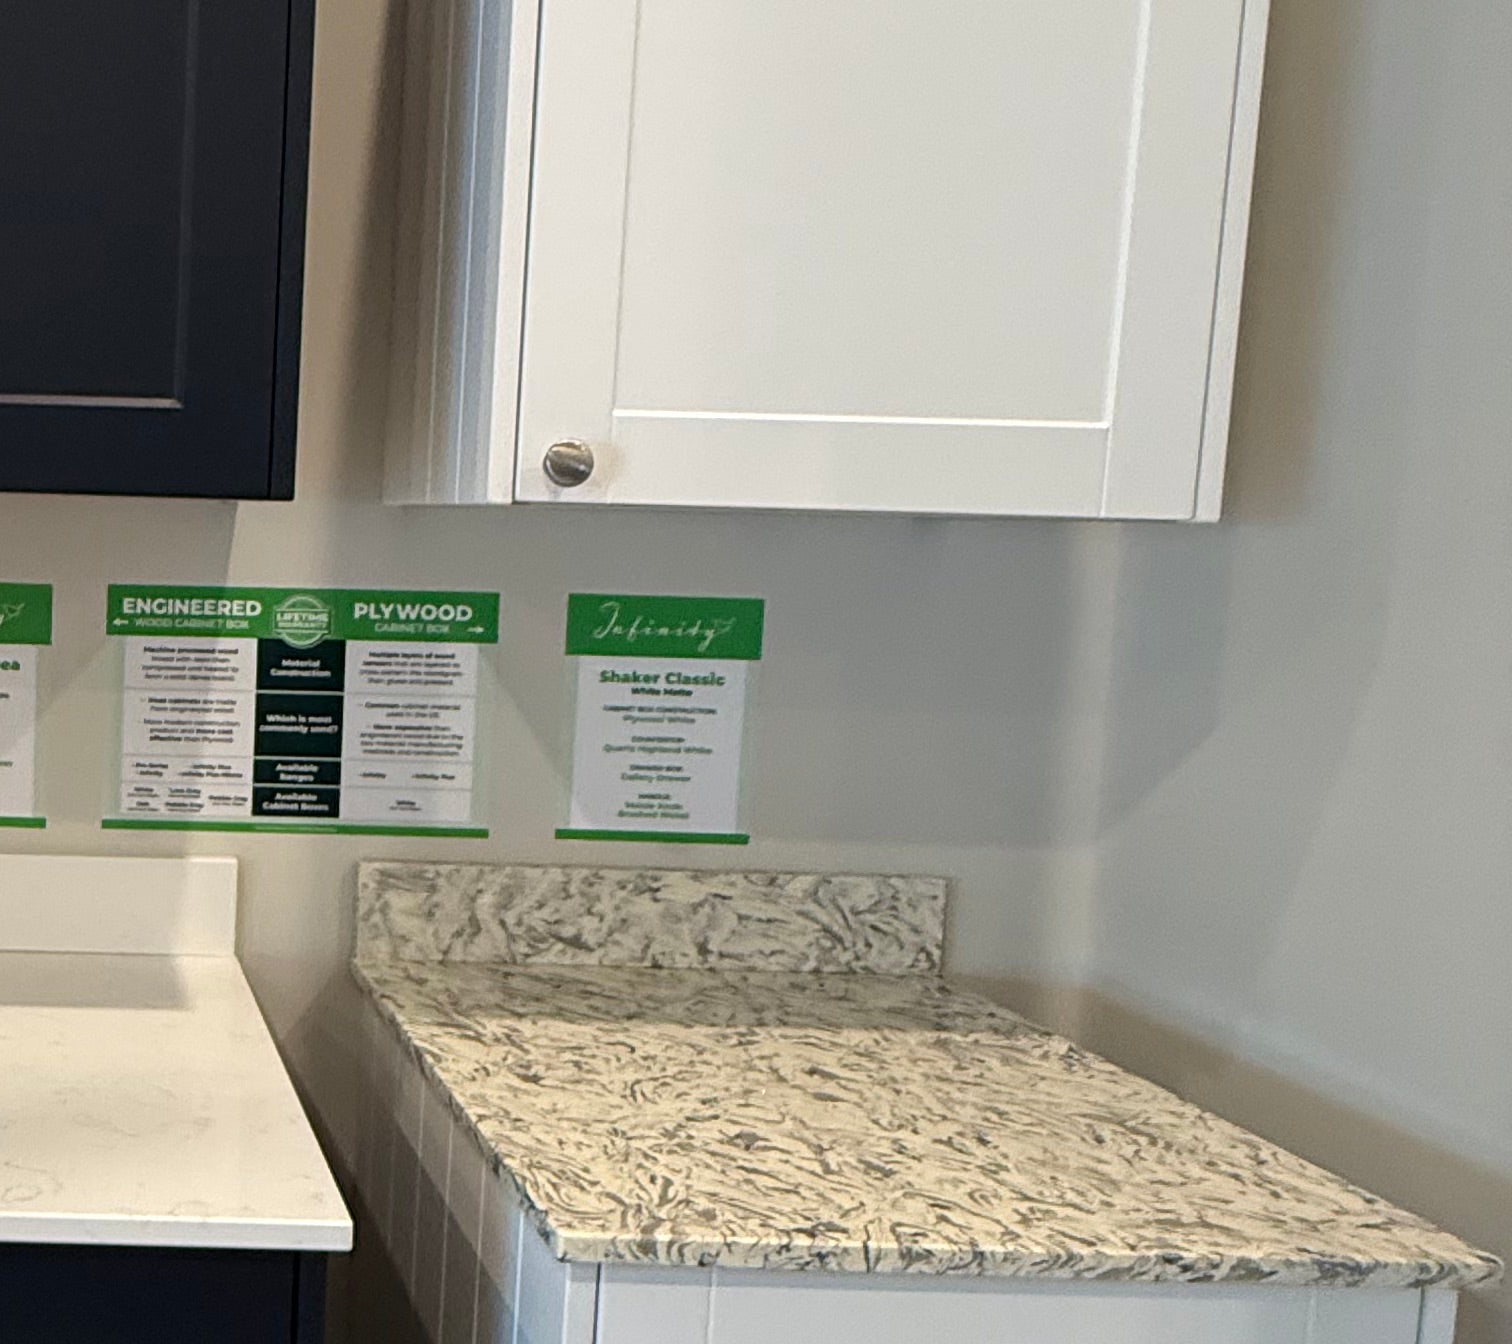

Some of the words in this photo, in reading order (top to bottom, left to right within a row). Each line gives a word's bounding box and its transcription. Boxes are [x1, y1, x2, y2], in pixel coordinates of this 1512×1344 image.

[122, 597, 262, 617] ENGINEERED
[354, 602, 473, 622] PLYWOOD
[226, 620, 249, 629] BOX
[276, 612, 329, 623] LIFETIME
[375, 623, 424, 633] CABINET
[426, 624, 450, 634] BOX
[593, 601, 716, 652] Infinity
[599, 669, 660, 684] Shaker
[665, 672, 726, 686] Classic
